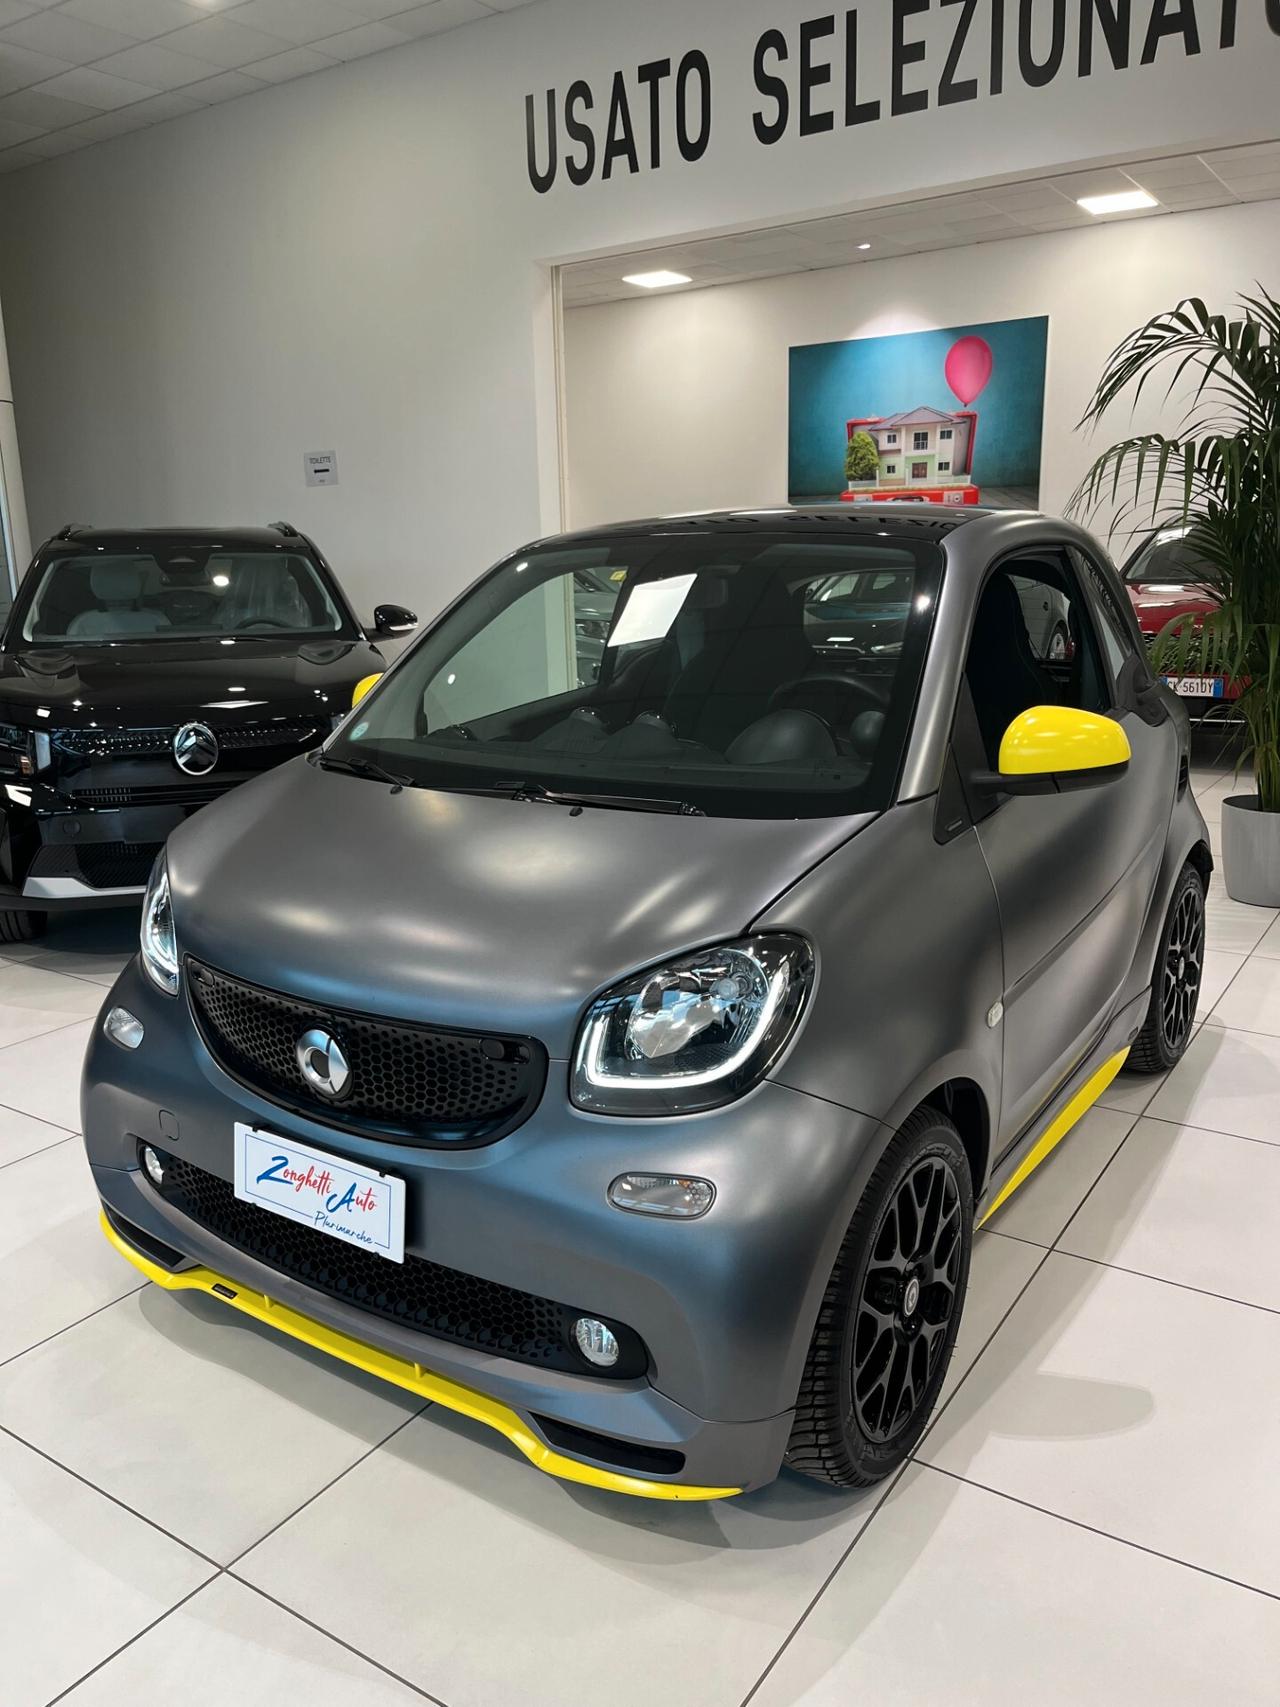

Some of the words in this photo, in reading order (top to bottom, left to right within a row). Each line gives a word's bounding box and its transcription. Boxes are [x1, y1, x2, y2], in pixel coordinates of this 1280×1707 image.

[525, 49, 712, 194] USATO
[752, 0, 1280, 145] SELEZIONA
[256, 1155, 335, 1195] Zonghetti
[326, 1182, 378, 1213] Auto
[313, 1210, 373, 1244] Plurimarche
